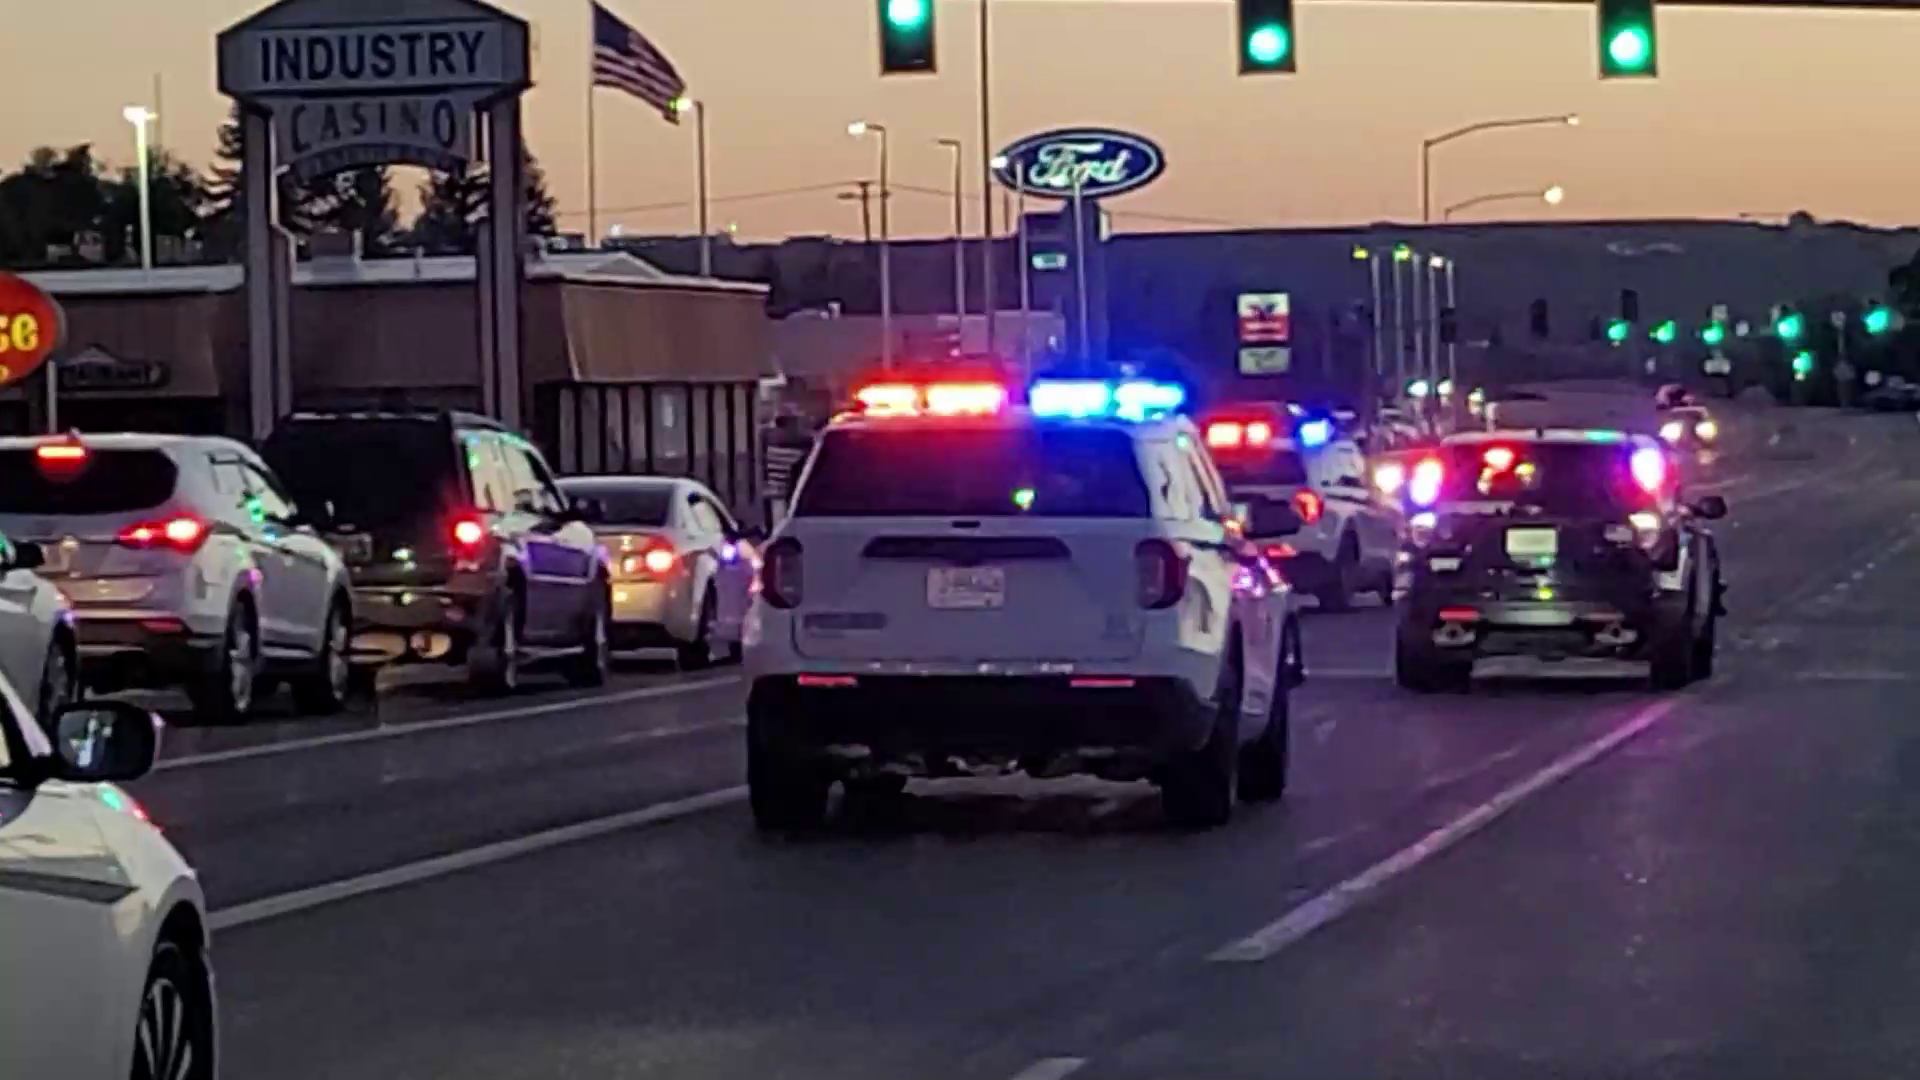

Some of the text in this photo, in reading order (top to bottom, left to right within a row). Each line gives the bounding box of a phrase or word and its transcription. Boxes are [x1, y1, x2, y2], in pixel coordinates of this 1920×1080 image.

[261, 30, 486, 83] INDUSTRY
[290, 98, 457, 154] CASINO
[1028, 141, 1133, 188] Ford
